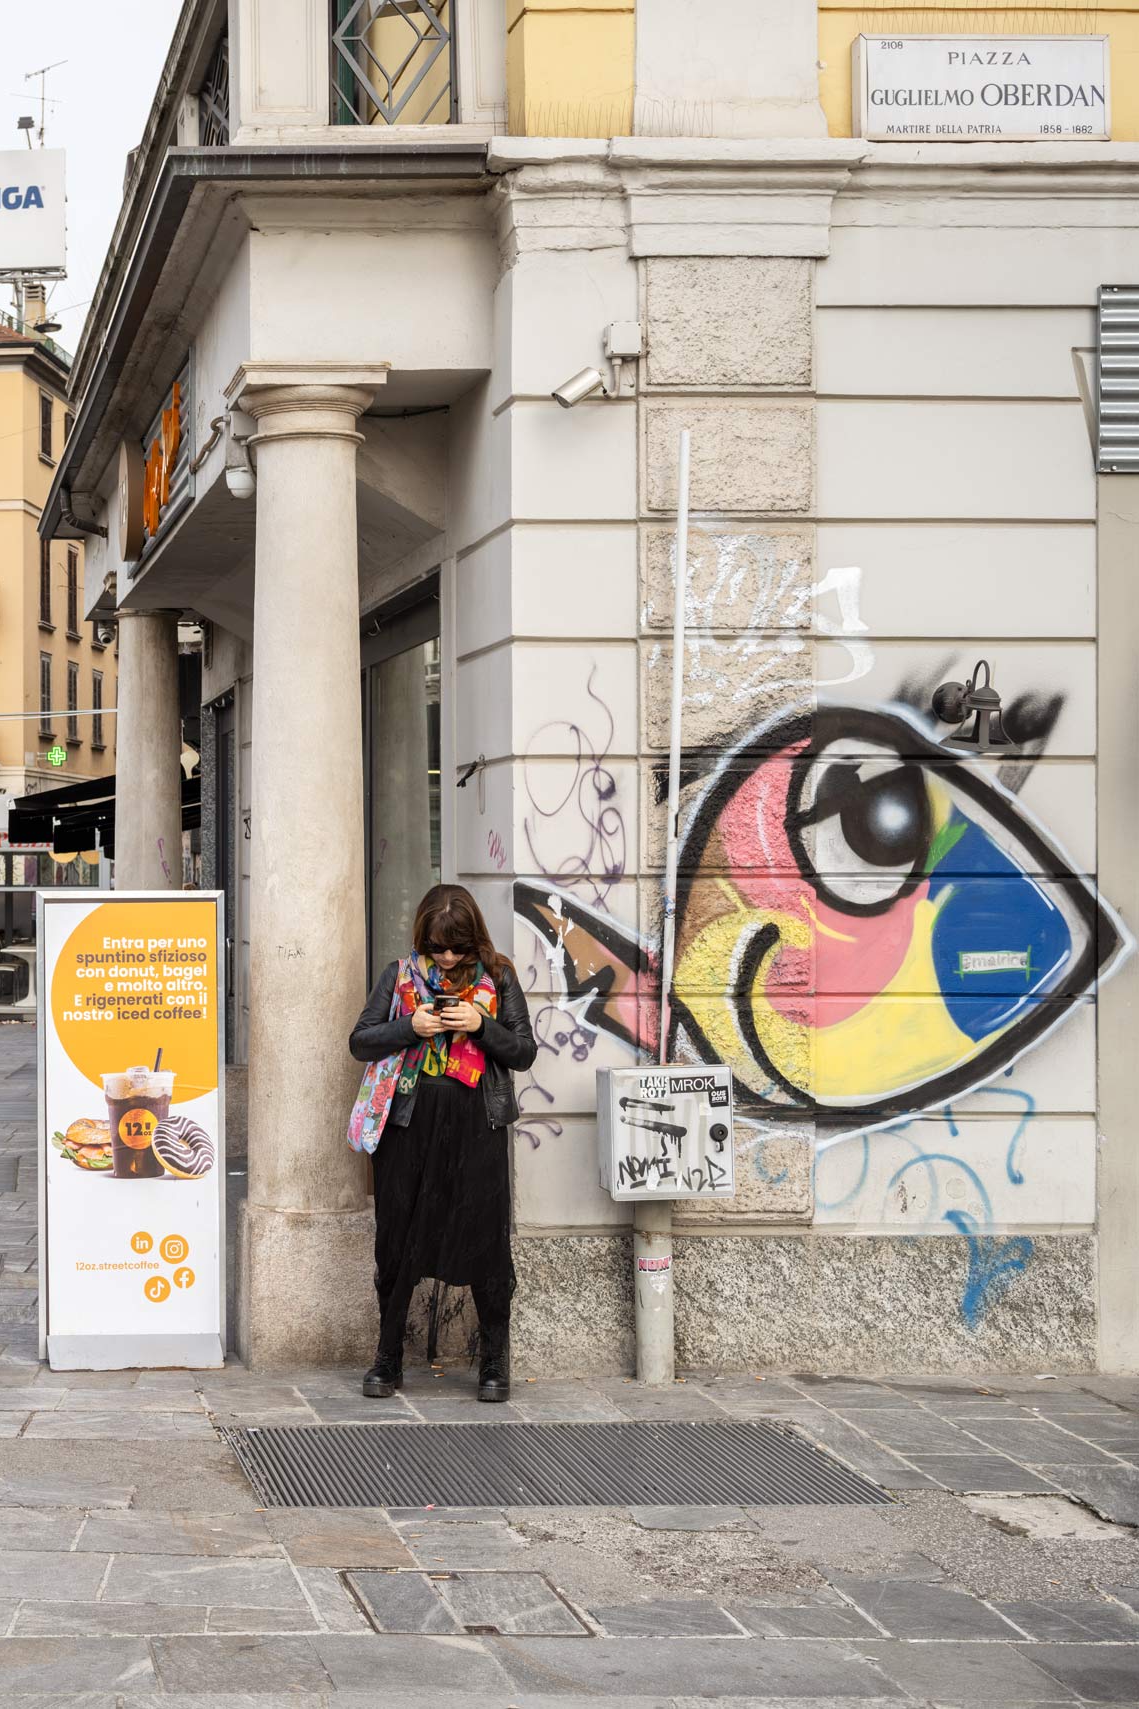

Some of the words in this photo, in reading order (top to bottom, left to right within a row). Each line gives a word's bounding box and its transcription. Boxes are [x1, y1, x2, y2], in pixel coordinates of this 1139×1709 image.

[881, 41, 903, 50] 2108
[948, 52, 1032, 65] PIAZZA
[871, 89, 974, 106] GUGLIELMO
[981, 83, 1105, 107] OBERDAN
[886, 124, 930, 134] MARTIRE
[936, 124, 963, 134] DELLA
[967, 124, 1002, 134] PATRIA
[1039, 125, 1062, 134] 1858
[1072, 125, 1093, 134] 1882
[103, 937, 144, 949] Entra
[148, 938, 173, 952] per
[177, 937, 207, 948] uno
[76, 950, 146, 967] spuntino
[149, 950, 207, 963] sfizioso
[76, 967, 105, 978] con
[108, 965, 159, 979] donut,
[163, 964, 207, 980] bagel
[104, 981, 114, 991] e
[117, 979, 163, 991] molto
[166, 979, 207, 991] altro.
[74, 995, 82, 1006] E
[86, 993, 163, 1009] rigenerati
[166, 995, 195, 1005] con
[198, 992, 207, 1004] il
[63, 1009, 114, 1021] nostro
[117, 1007, 150, 1020] iced
[153, 1006, 207, 1019] coffee!
[671, 1077, 715, 1092] MROK
[125, 1122, 143, 1136] 12
[75, 1260, 160, 1271] 12oz.streetcoffee
